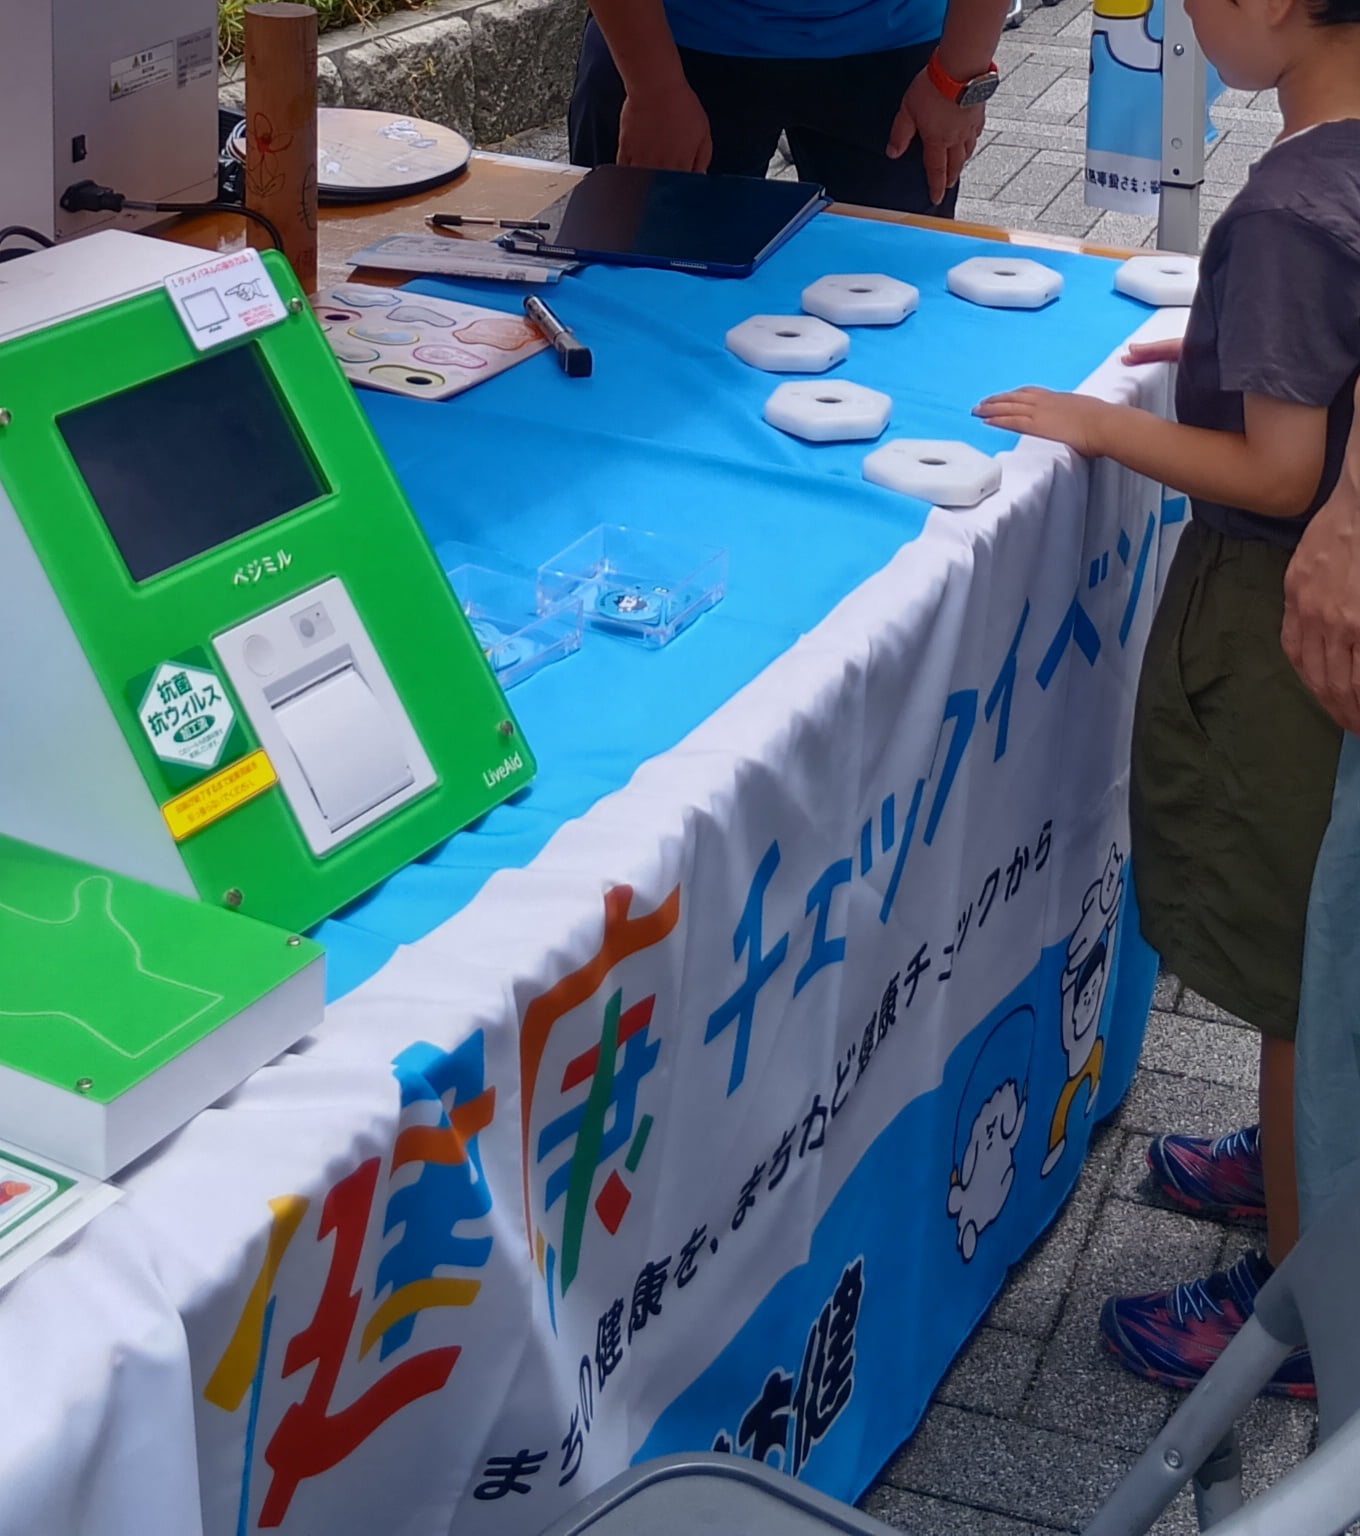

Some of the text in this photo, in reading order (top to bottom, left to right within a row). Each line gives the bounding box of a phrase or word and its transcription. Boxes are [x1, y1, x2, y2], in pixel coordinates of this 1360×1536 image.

[233, 549, 292, 585] ベジミル
[156, 671, 193, 705] 抗菌
[147, 684, 223, 737] 抗ウィルス
[483, 751, 523, 788] LiveAid
